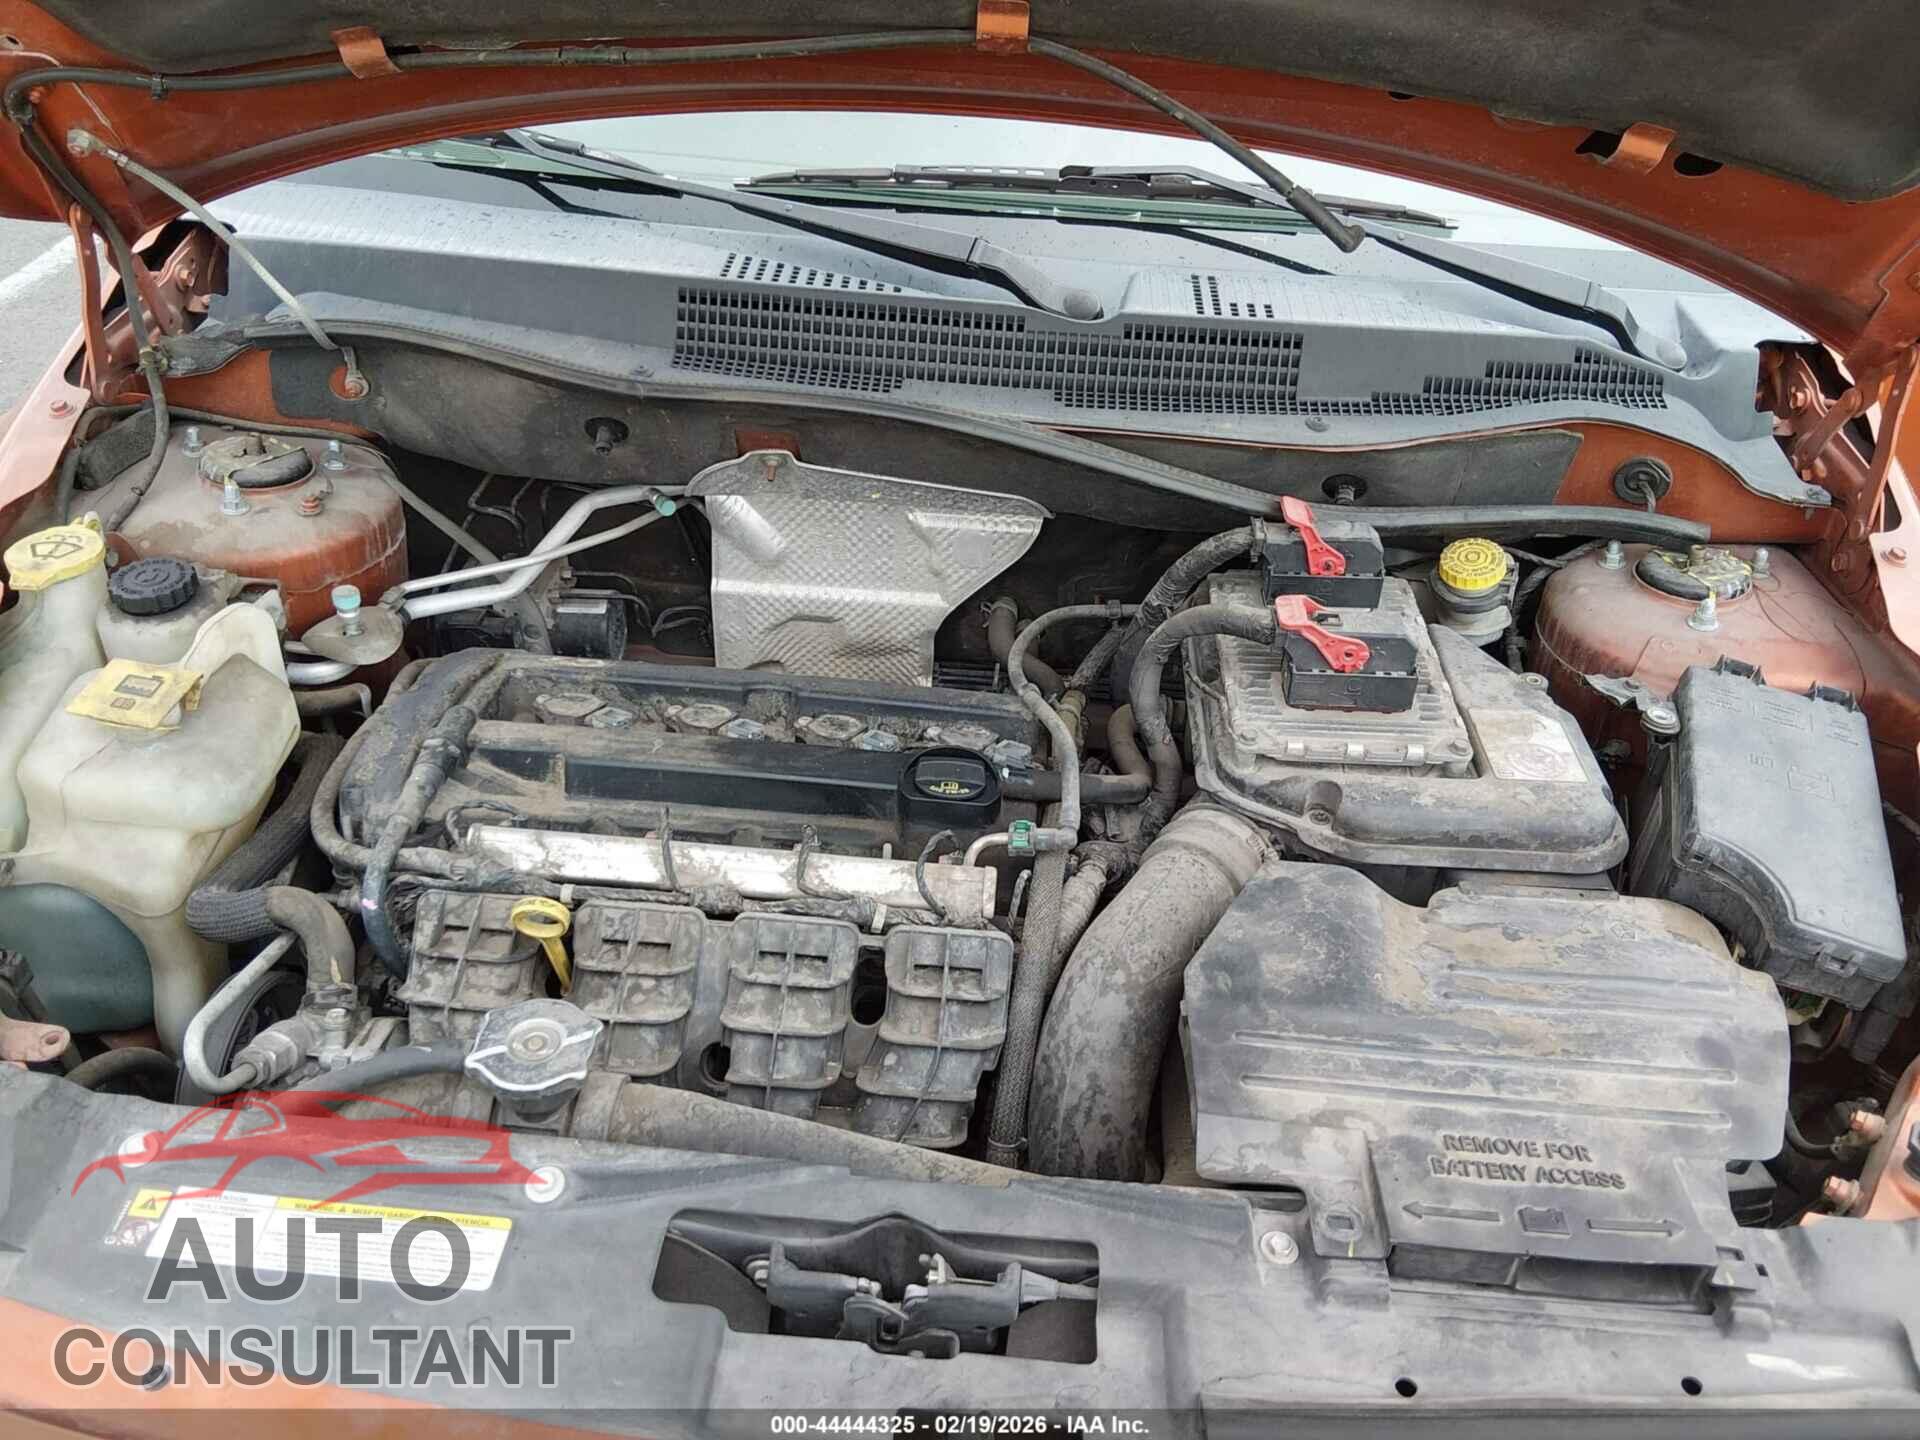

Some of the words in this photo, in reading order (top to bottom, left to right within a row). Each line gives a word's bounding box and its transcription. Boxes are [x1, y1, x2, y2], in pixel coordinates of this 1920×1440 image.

[1442, 1134, 1540, 1159] REMOVE
[1543, 1140, 1593, 1163] FOR
[1430, 1155, 1528, 1182] BATTERY
[1535, 1166, 1626, 1190] ACCESS
